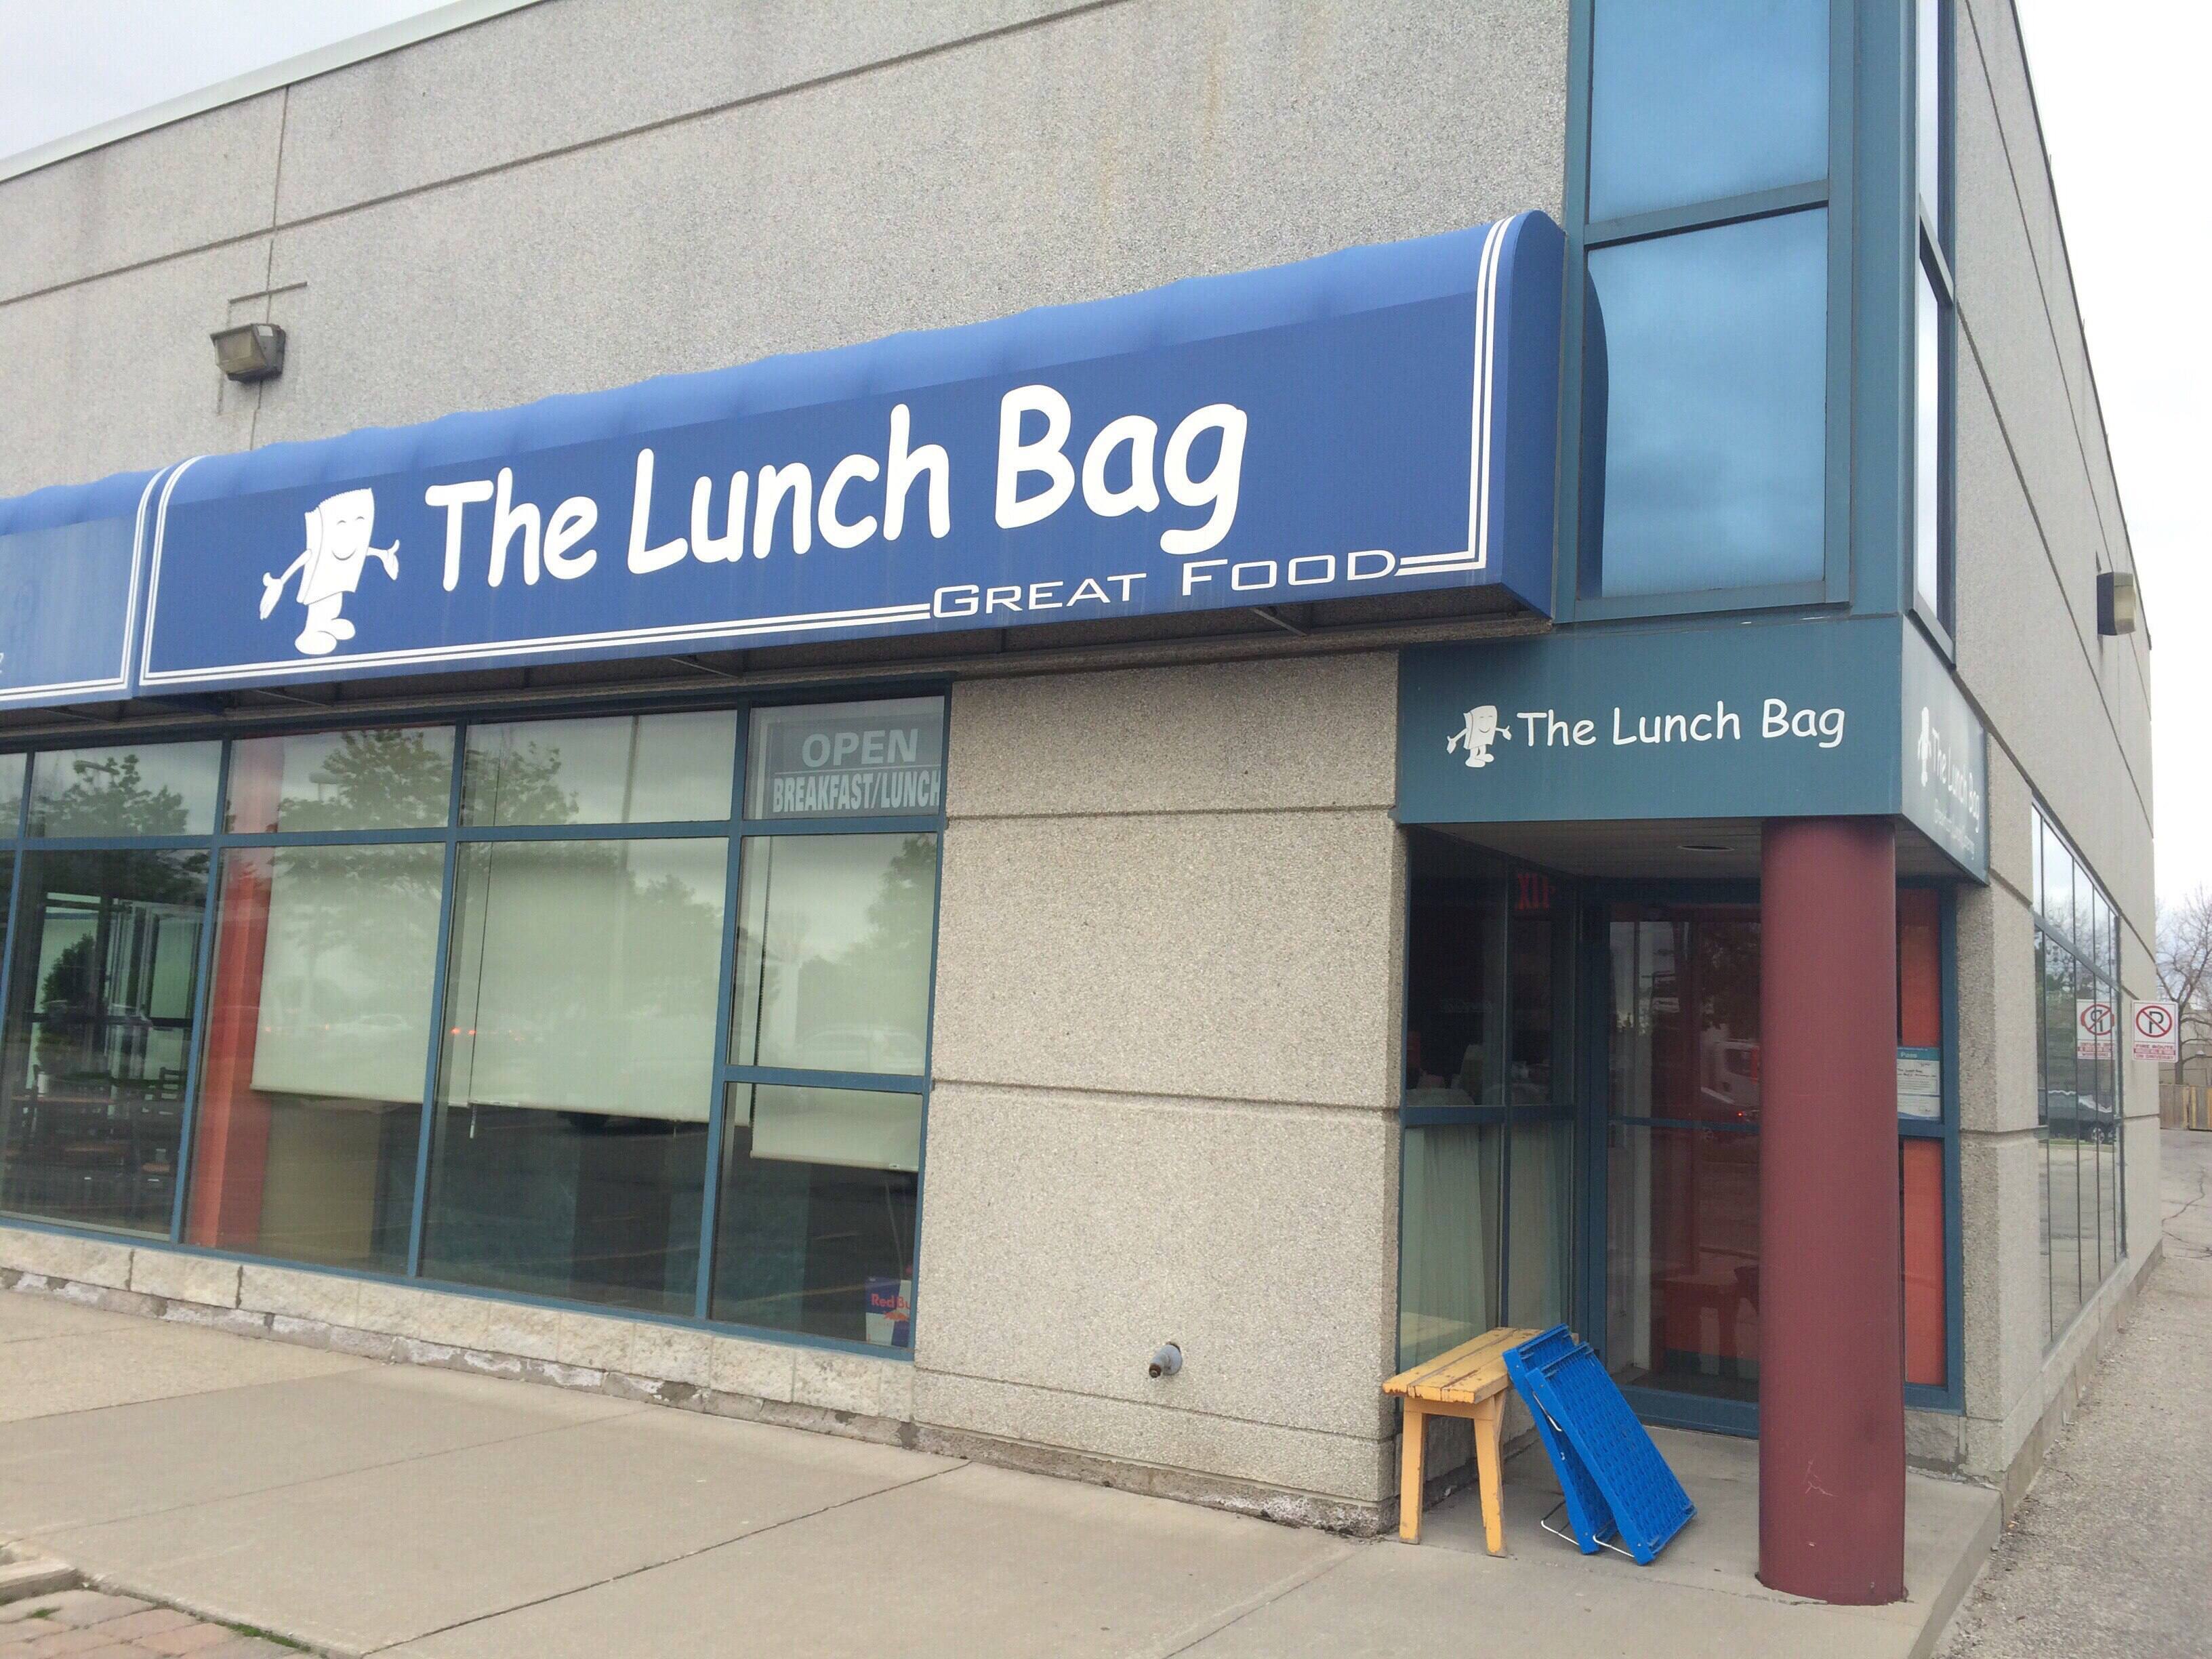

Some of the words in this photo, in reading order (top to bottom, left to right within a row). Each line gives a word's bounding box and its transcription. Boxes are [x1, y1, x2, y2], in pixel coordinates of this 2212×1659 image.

[425, 467, 598, 592] The
[628, 403, 950, 574] Lunch
[995, 384, 1248, 555] Bag
[933, 573, 1147, 618] GREAT
[1182, 550, 1397, 596] FOOD
[1516, 709, 1597, 747] The
[1612, 701, 1741, 745] Lunch
[1761, 698, 1845, 748] Bag
[802, 729, 919, 768] OPEN
[773, 769, 942, 813] BREAKFAST/LUNCH
[871, 1293, 895, 1308] Red
[897, 1296, 911, 1309] Bu
